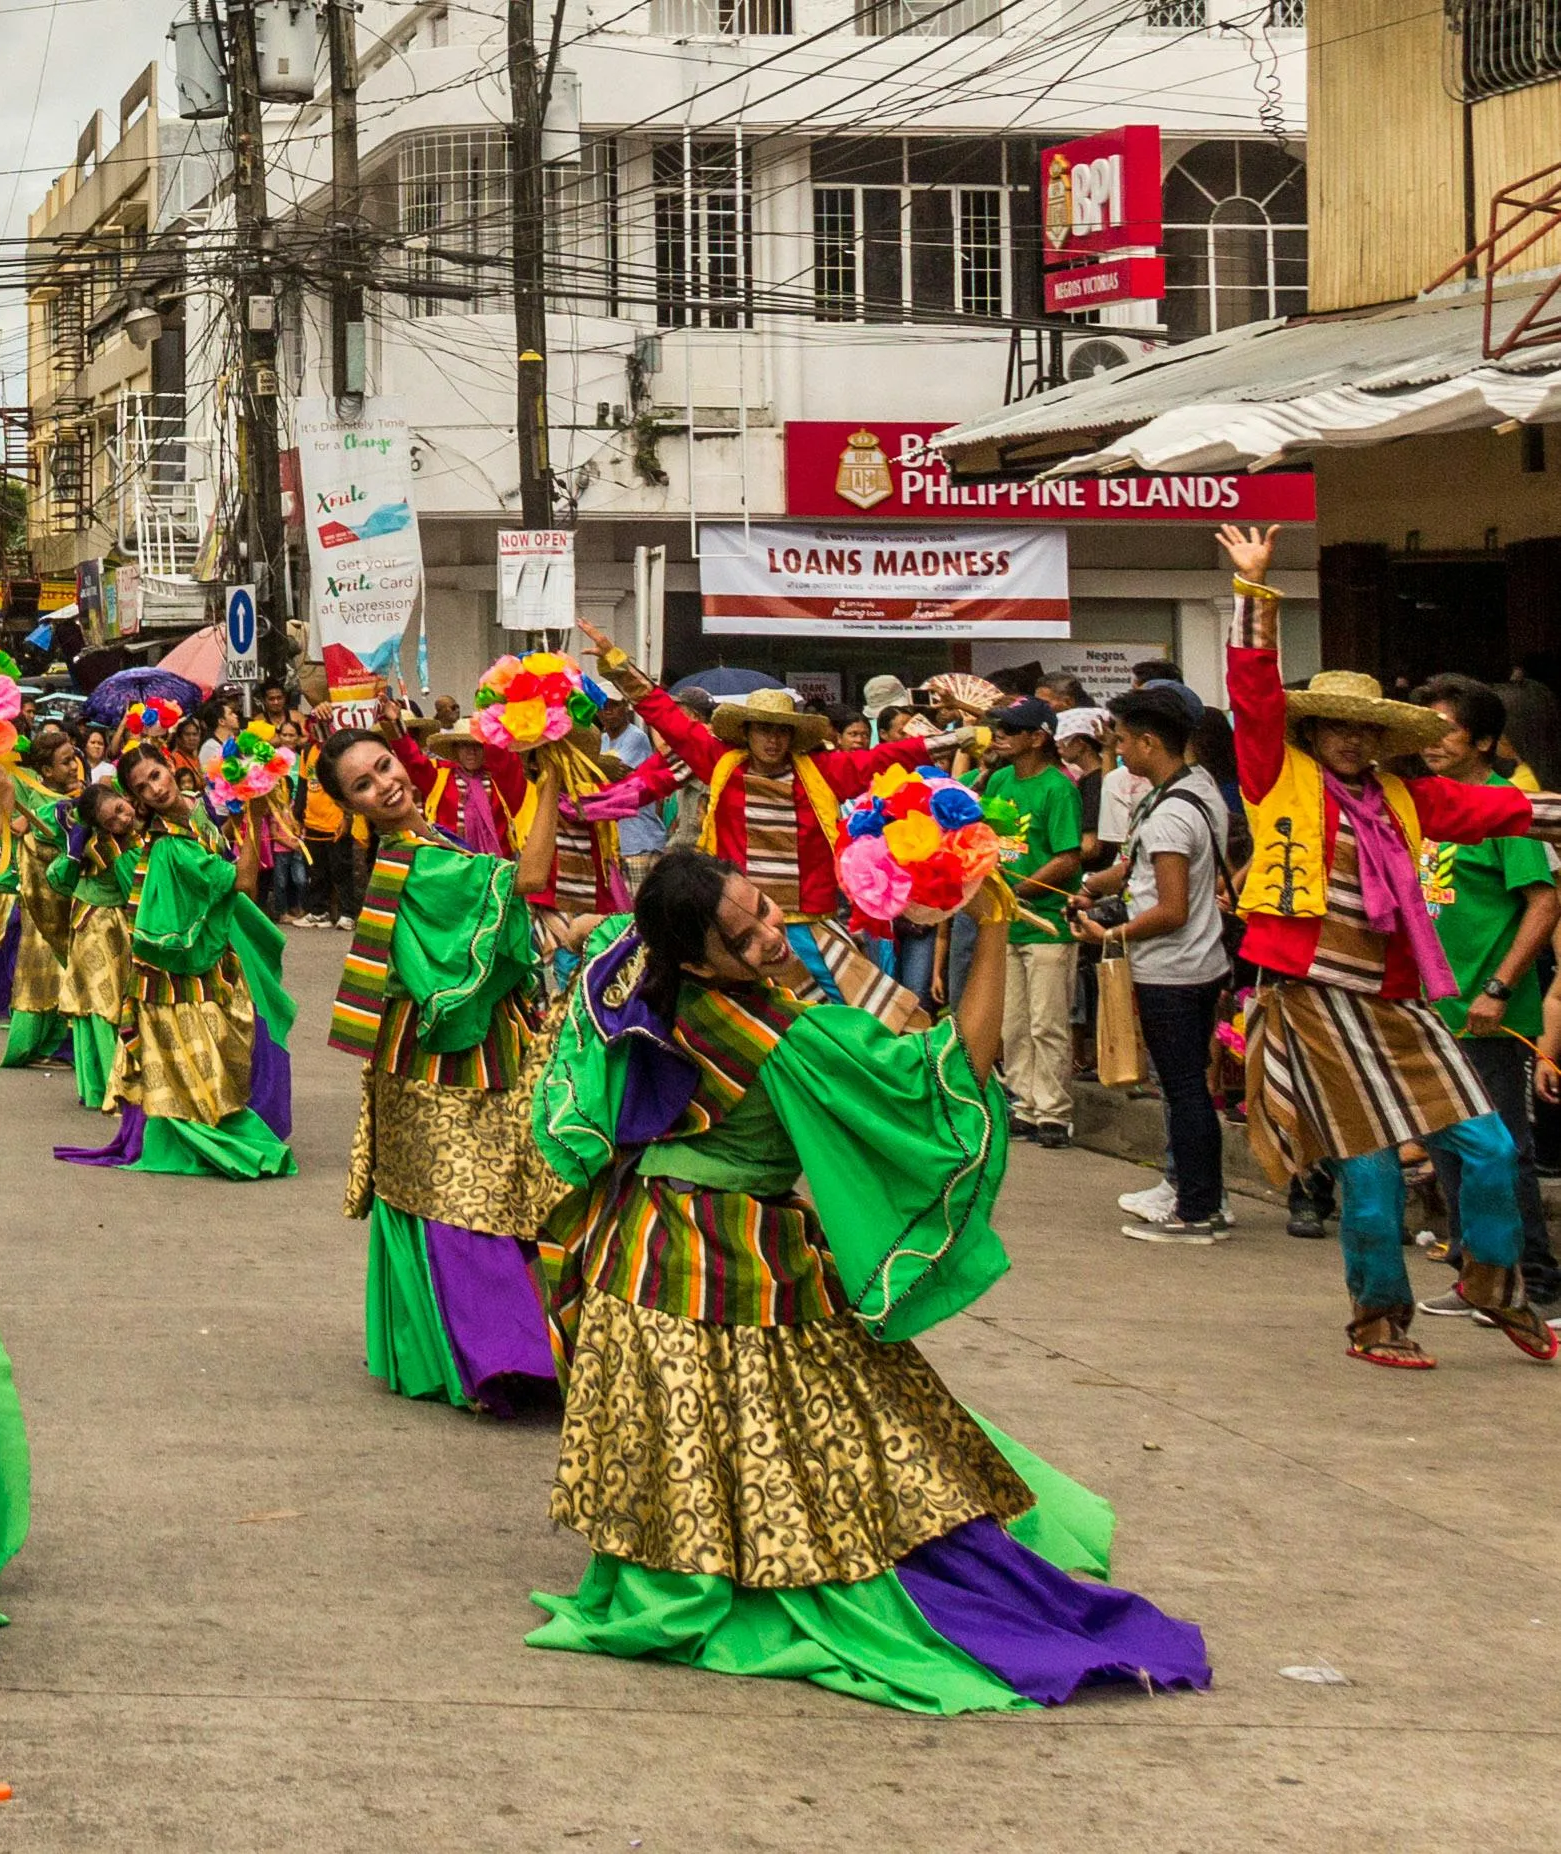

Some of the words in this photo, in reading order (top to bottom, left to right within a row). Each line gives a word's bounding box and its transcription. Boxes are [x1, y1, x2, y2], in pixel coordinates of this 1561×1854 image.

[1071, 154, 1122, 236] BPI
[1054, 279, 1081, 300] NEGROS
[1083, 272, 1119, 295] VICTORIAS
[301, 422, 318, 433] It's
[320, 420, 373, 432] Definitely
[378, 418, 405, 429] Time
[314, 440, 329, 451] for
[900, 470, 1086, 505] PHILIPPINE
[1098, 476, 1240, 509] ISLANDS
[501, 534, 529, 547] NOW
[535, 533, 567, 547] OPEN
[336, 559, 361, 571] Get
[363, 558, 397, 573] your
[768, 548, 862, 575] LOANS
[873, 550, 1010, 577] MADNESS
[380, 575, 413, 589] Card
[321, 604, 334, 615] at
[342, 611, 401, 624] Victorias
[1086, 650, 1127, 662] Negros,
[228, 660, 242, 678] ONE
[243, 660, 257, 678] WAY
